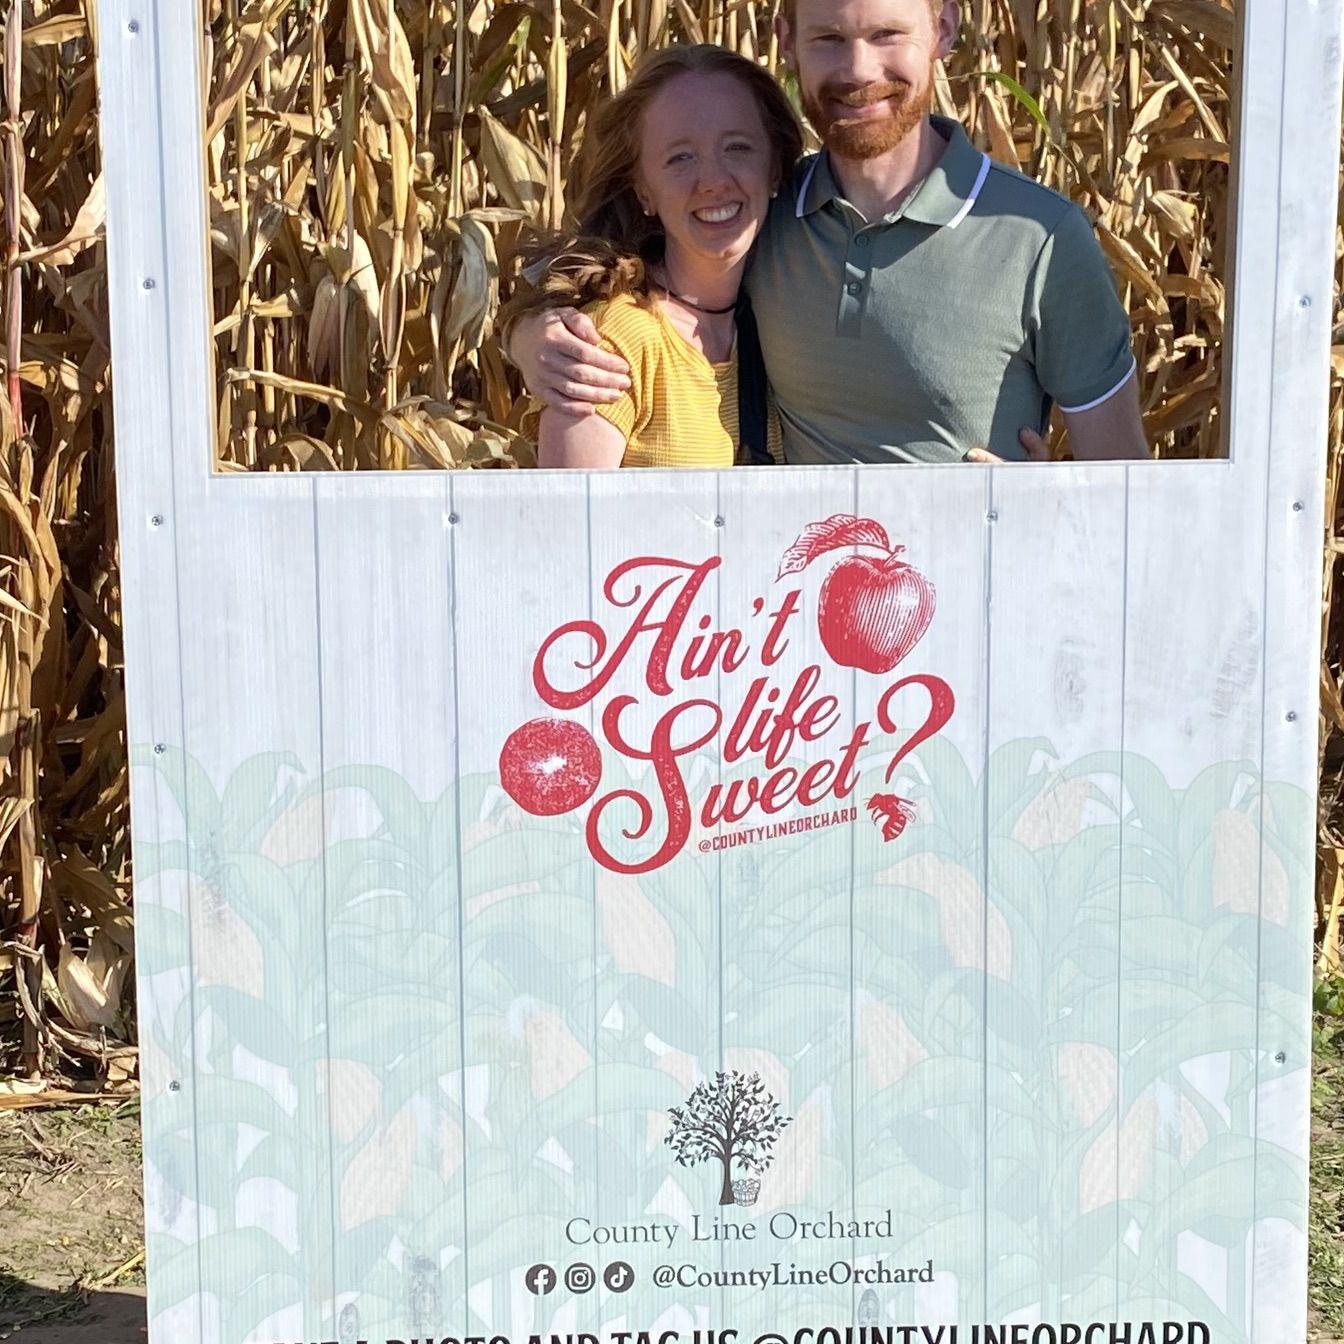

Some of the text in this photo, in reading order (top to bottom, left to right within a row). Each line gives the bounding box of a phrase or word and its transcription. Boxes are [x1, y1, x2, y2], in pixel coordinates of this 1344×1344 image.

[533, 556, 802, 710] Ain't
[724, 665, 841, 770] life
[585, 674, 955, 875] Sweet?
[698, 806, 858, 853] @COUNTYLINEORCHARD
[565, 1209, 894, 1248] County Line Orchard
[652, 1260, 935, 1291] @CountyLineOrchard
